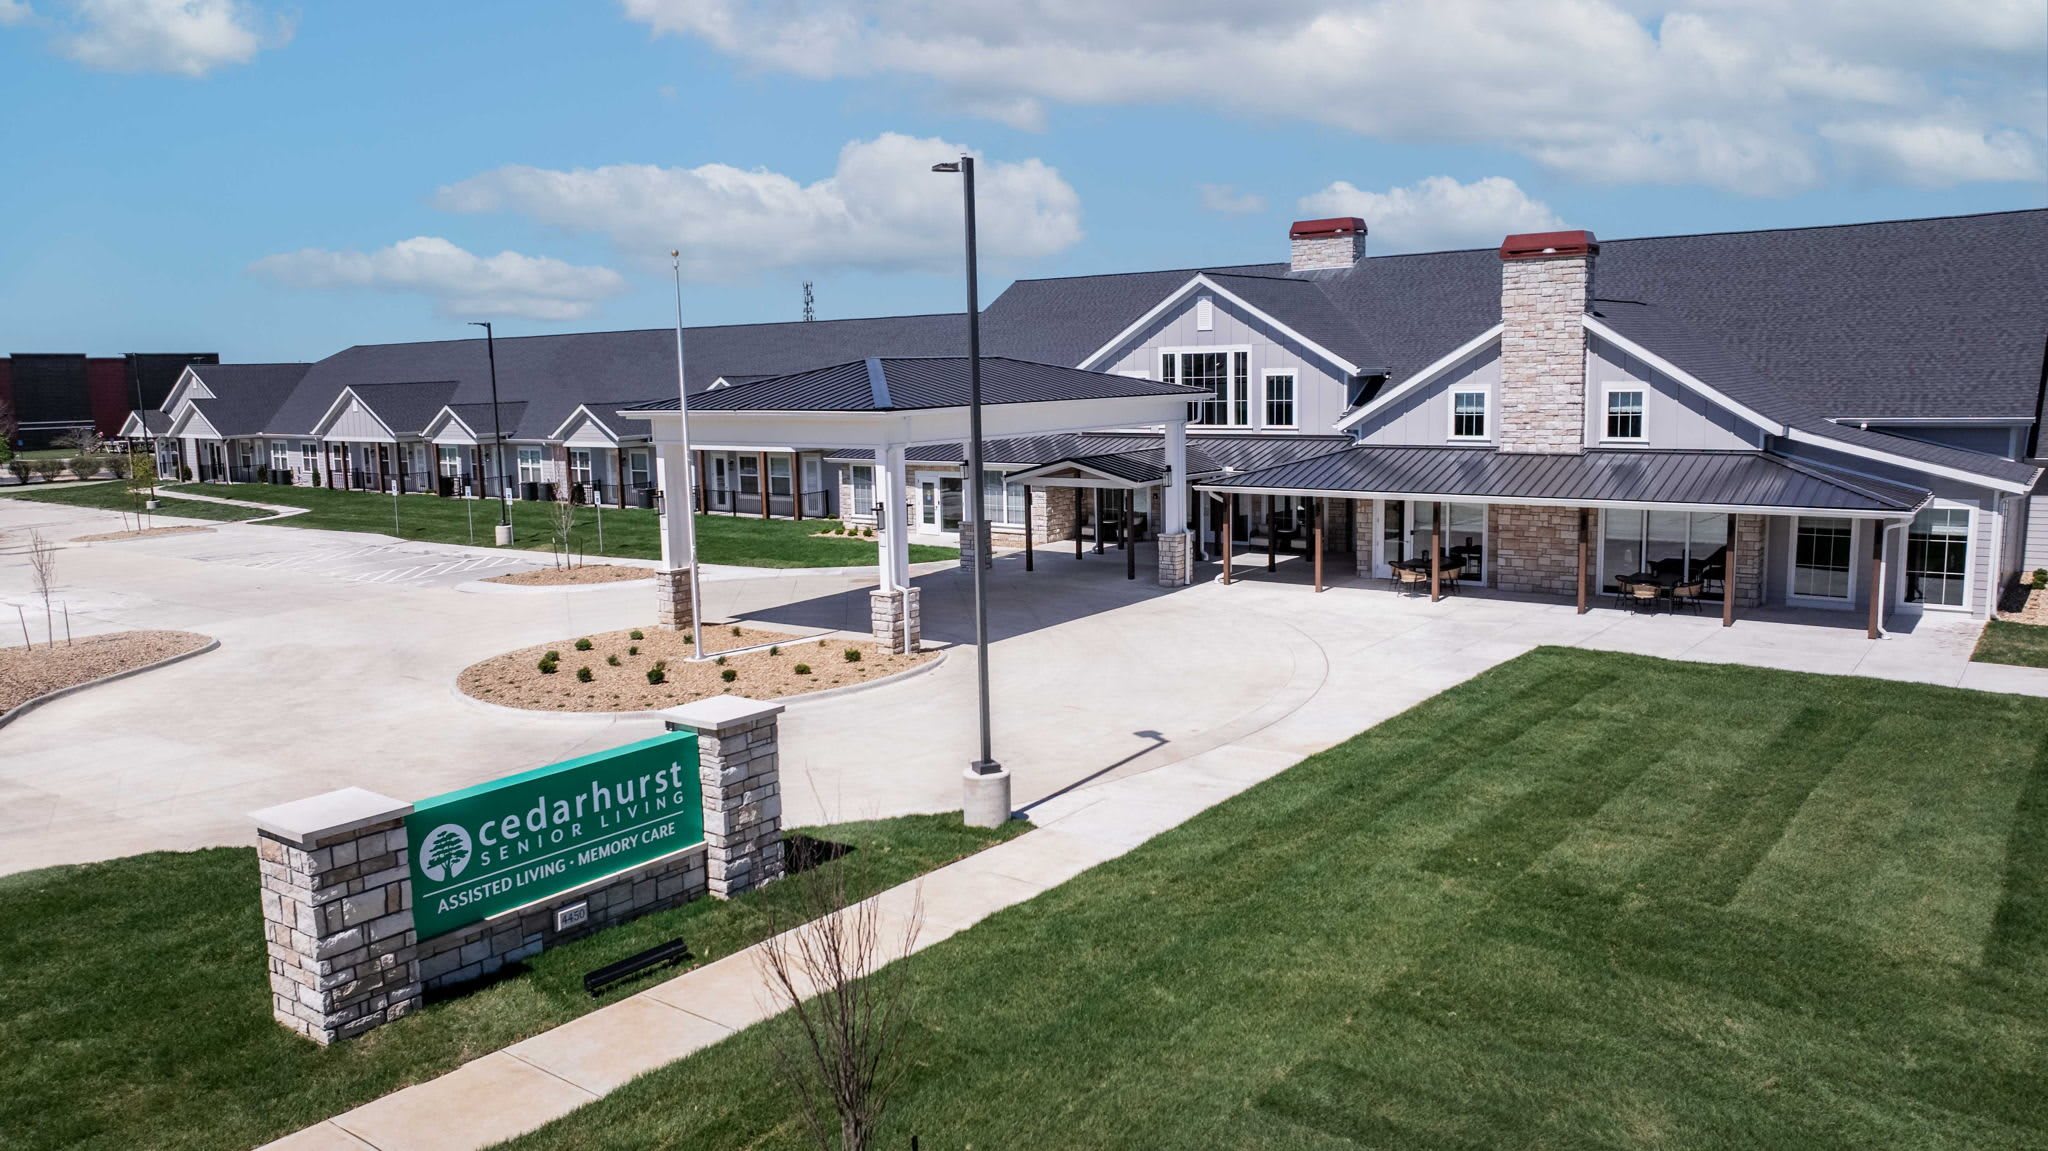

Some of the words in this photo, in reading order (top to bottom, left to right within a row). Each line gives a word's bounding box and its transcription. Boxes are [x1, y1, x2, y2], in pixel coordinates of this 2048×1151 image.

[478, 761, 682, 846] cedarhurst
[481, 823, 582, 866] SENIOR
[601, 791, 684, 828] LIVING
[437, 877, 513, 914] ASSISTED
[516, 859, 566, 887] LIVING
[578, 834, 639, 866] MEMORY
[642, 822, 676, 844] CARE
[562, 908, 585, 924] 4450
